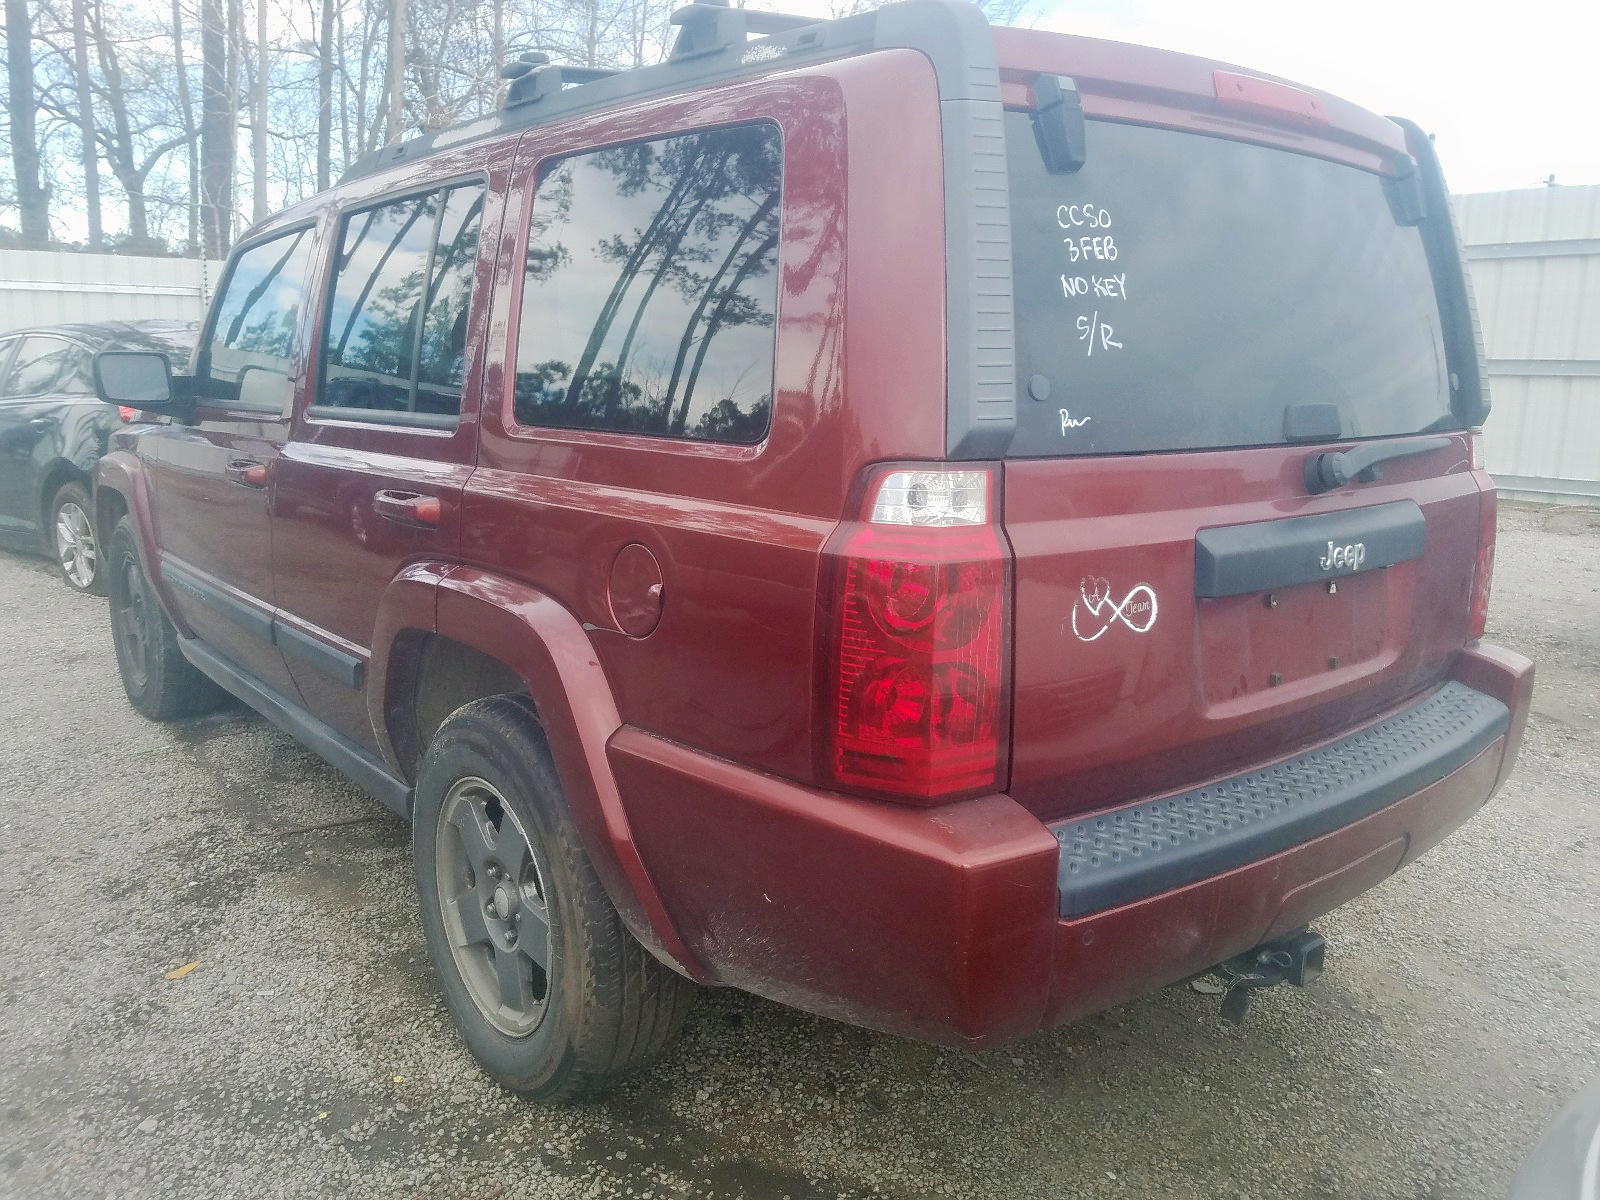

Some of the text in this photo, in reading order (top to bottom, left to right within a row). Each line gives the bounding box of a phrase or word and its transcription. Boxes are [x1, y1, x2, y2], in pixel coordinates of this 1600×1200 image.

[1060, 273, 1127, 300] NO KEY
[1319, 541, 1366, 571] Jeep
